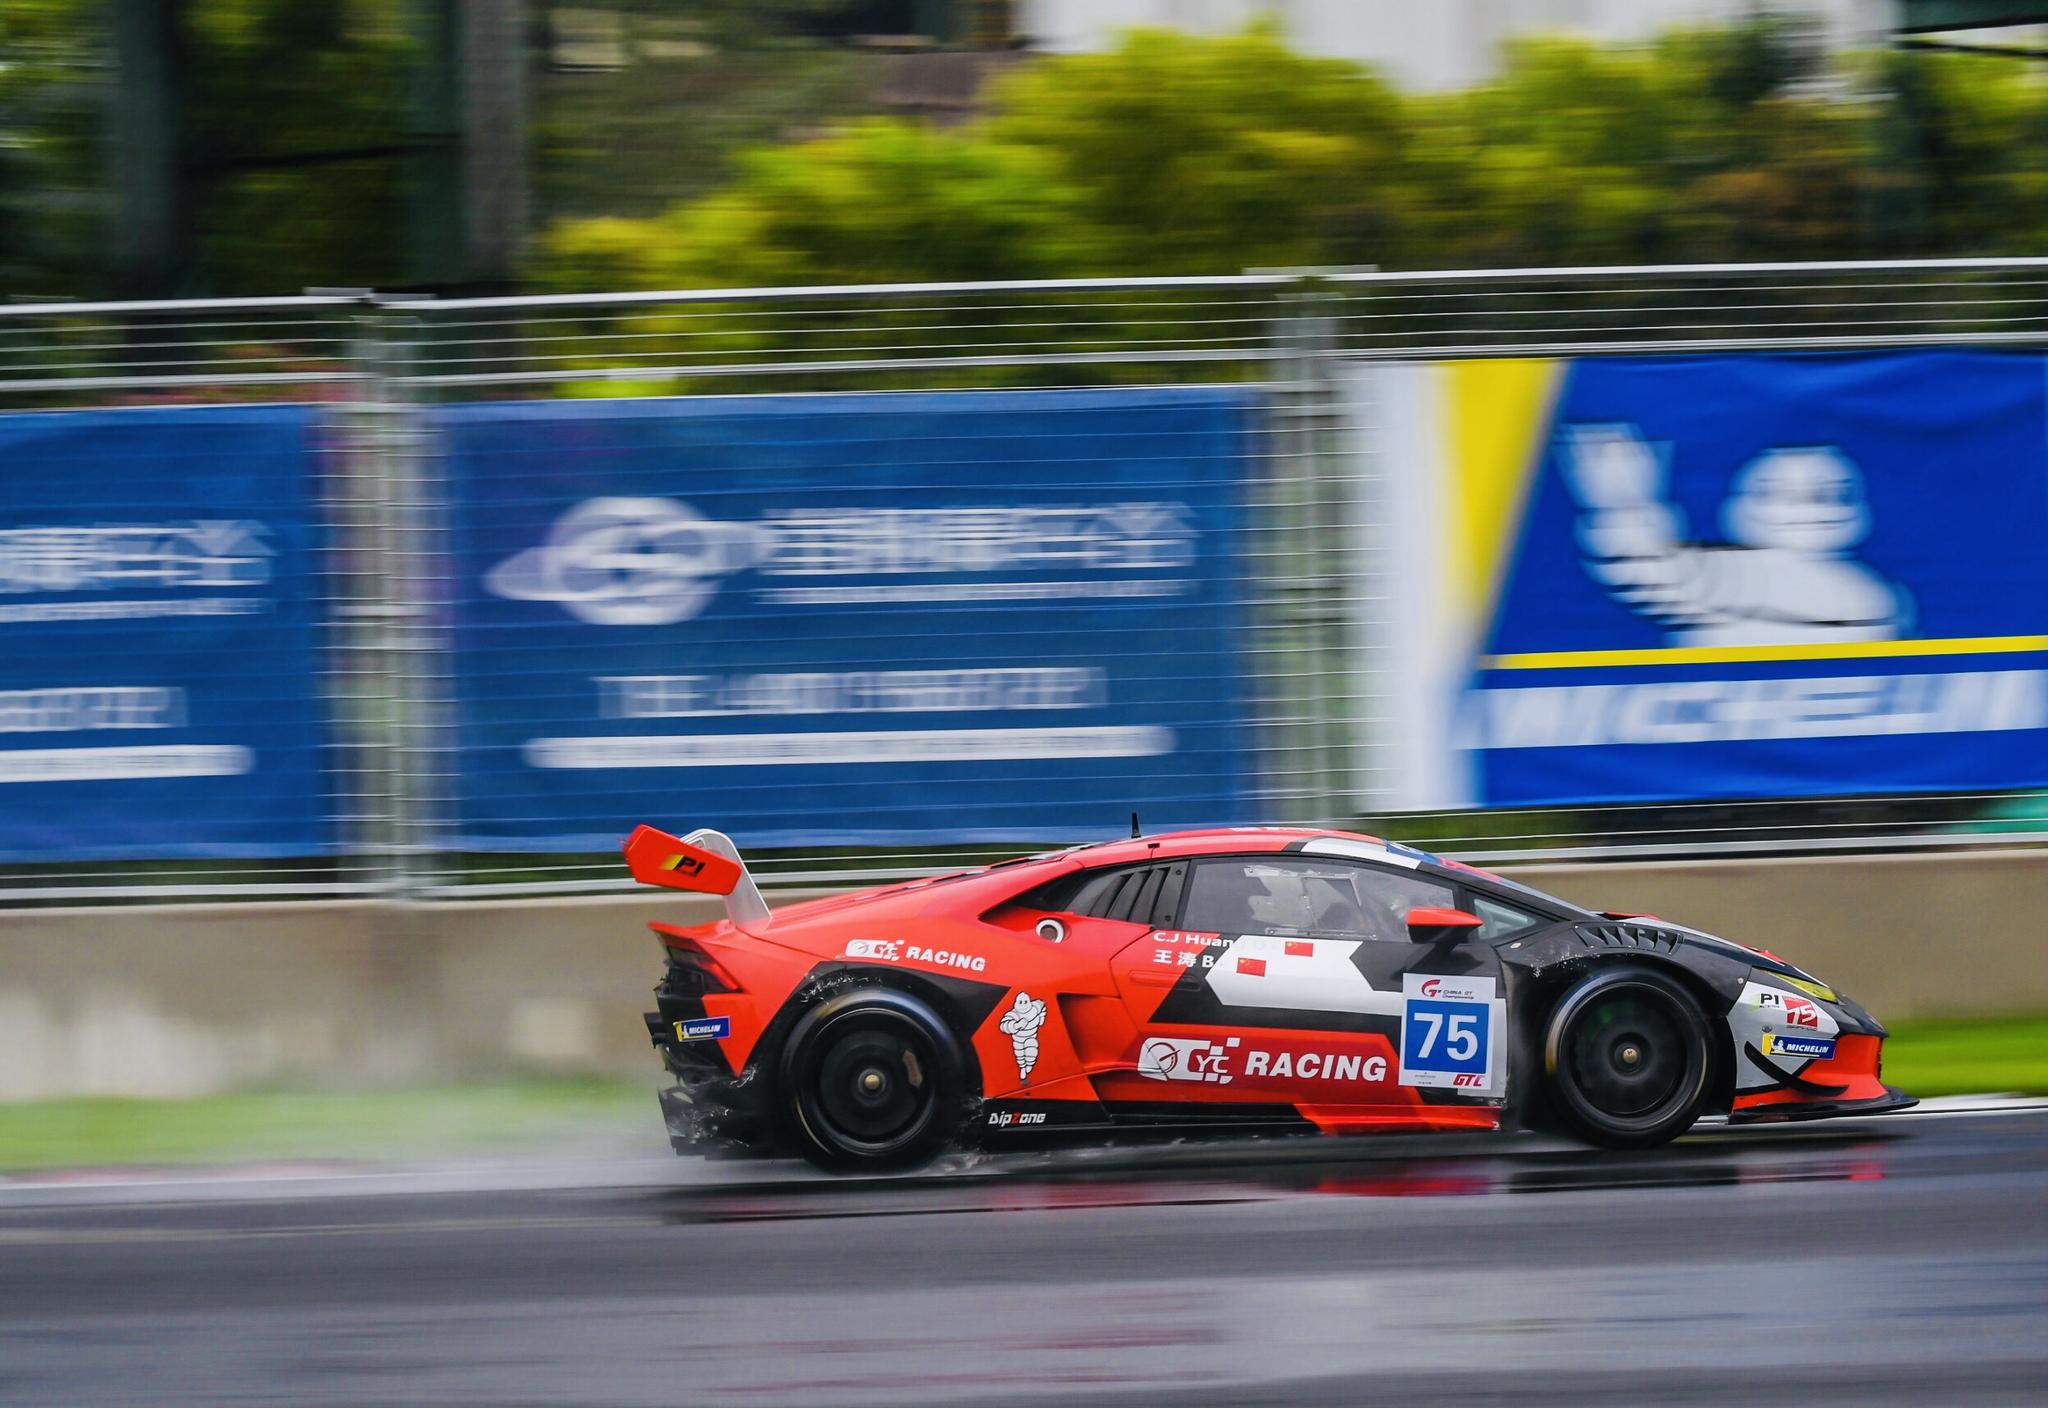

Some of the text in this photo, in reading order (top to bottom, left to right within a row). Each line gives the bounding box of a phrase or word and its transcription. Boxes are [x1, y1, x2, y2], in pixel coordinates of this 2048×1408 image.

[1153, 932, 1179, 943] C.J
[905, 946, 986, 971] RACING
[1760, 993, 1779, 1004] P1
[1414, 1012, 1478, 1060] 75
[1786, 1043, 1829, 1053] MICHELIN
[1245, 1051, 1386, 1082] RACING
